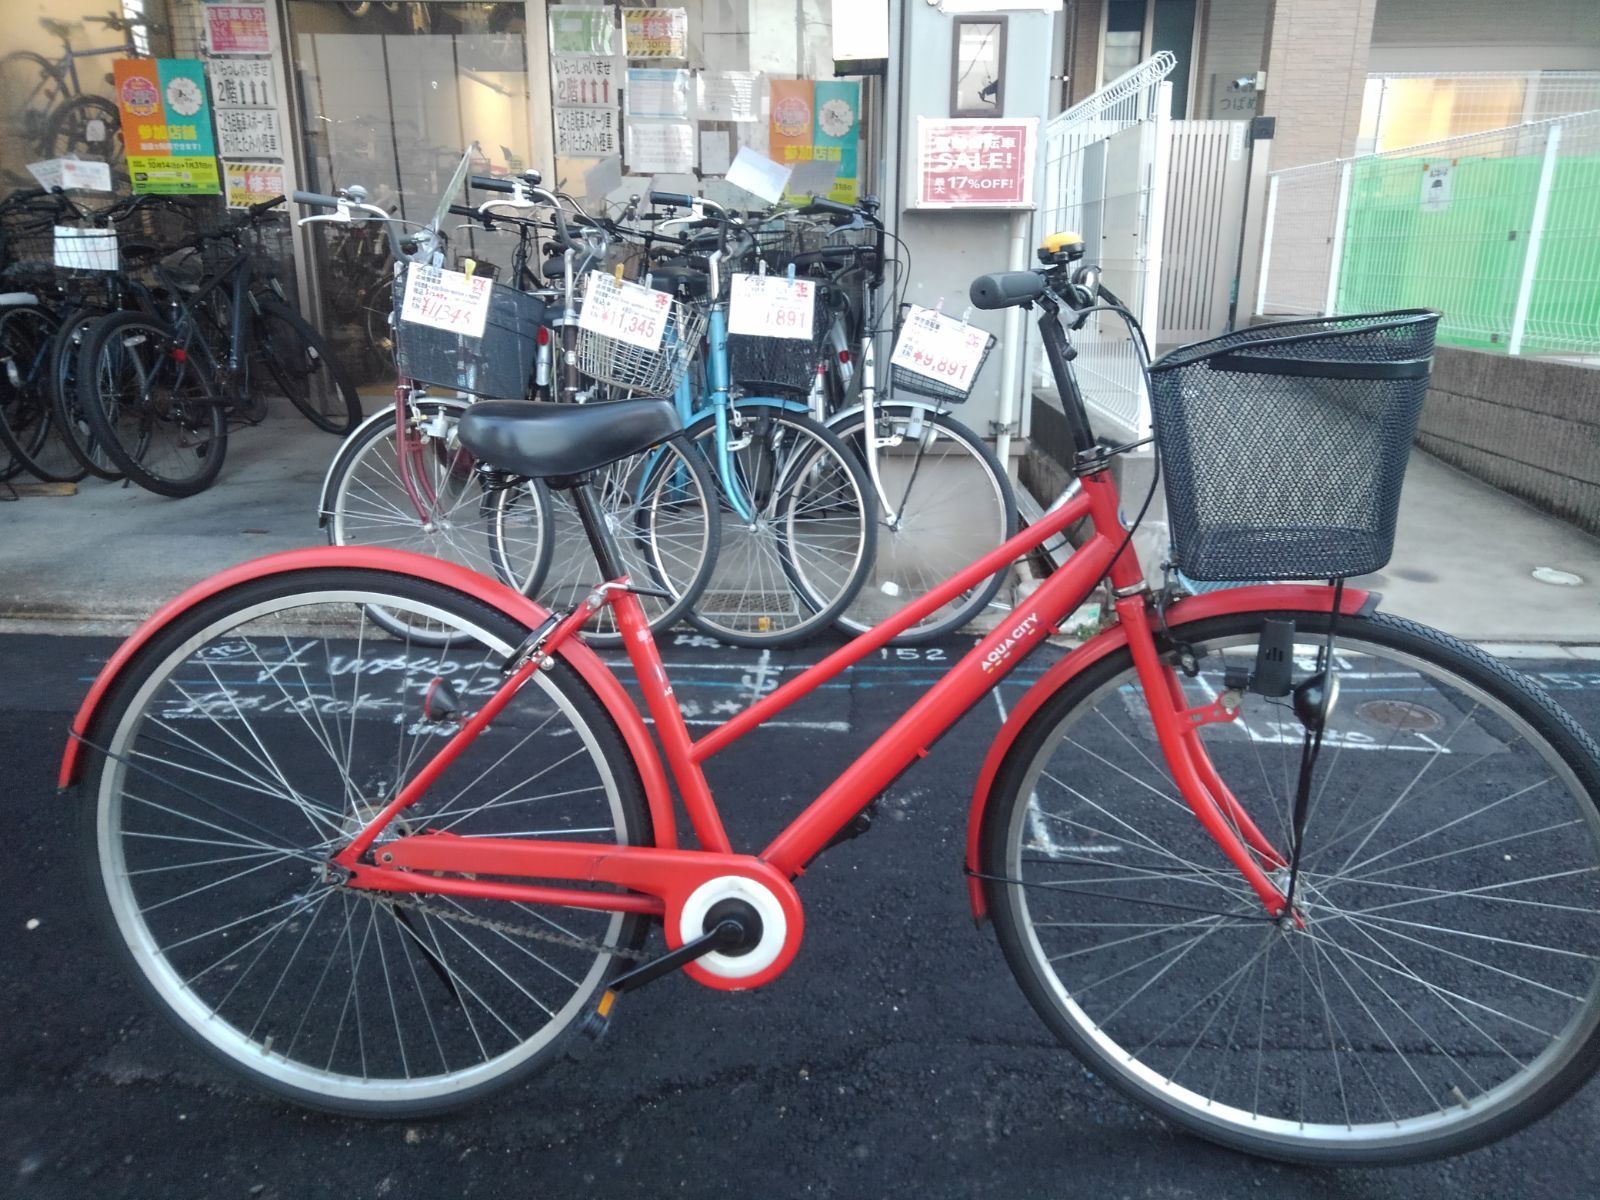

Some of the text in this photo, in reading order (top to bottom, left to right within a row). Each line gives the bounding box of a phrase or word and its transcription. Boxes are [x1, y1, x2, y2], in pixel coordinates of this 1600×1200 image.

[556, 60, 611, 75] いらっしゃいませ
[218, 79, 238, 104] 2階
[559, 77, 578, 103] 2階
[937, 151, 1012, 169] SALE!
[947, 176, 1014, 189] 17%OFF!
[981, 612, 1038, 671] AQUA CITY
[880, 647, 947, 661] 152
